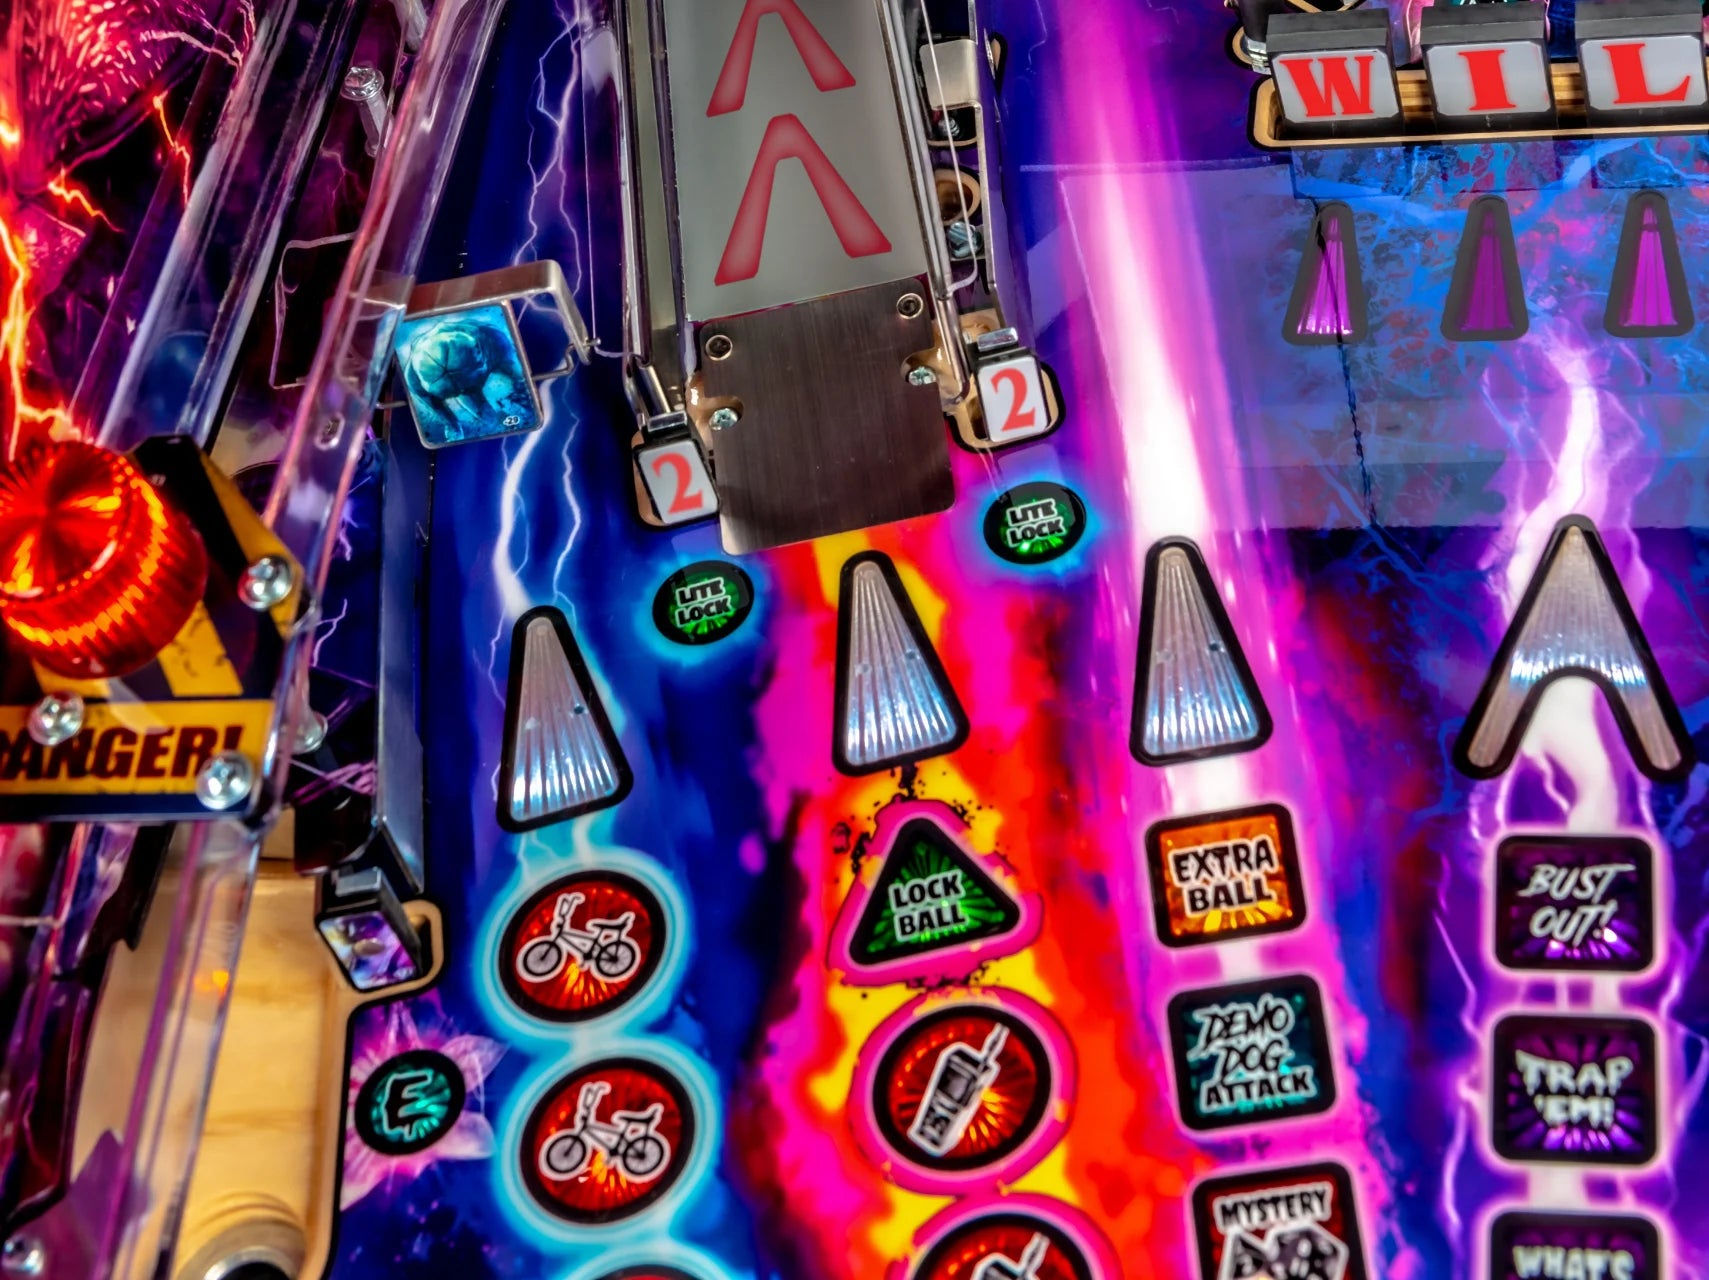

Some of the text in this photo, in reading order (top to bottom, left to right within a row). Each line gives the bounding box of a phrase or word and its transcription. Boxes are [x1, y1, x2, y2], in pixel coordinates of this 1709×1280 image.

[990, 367, 1036, 432] 2
[651, 452, 703, 515] 2
[1008, 500, 1057, 525] LITE
[1008, 519, 1065, 546] LOCK
[676, 578, 725, 605] LITE
[676, 596, 731, 627] LOCK
[1170, 837, 1276, 884] EXTRA
[891, 871, 964, 910] LOCK
[1185, 875, 1275, 914] BALL
[1517, 863, 1636, 904] BUST
[896, 902, 968, 938] BALL
[1530, 899, 1618, 947] OUT!
[1192, 995, 1293, 1056] DEMO
[1218, 1038, 1292, 1084] DOG
[1515, 1049, 1633, 1096] TRAP
[1203, 1068, 1315, 1110] ATTACK
[1534, 1094, 1615, 1130] 'EM!
[1216, 1184, 1331, 1230] MYSTERY
